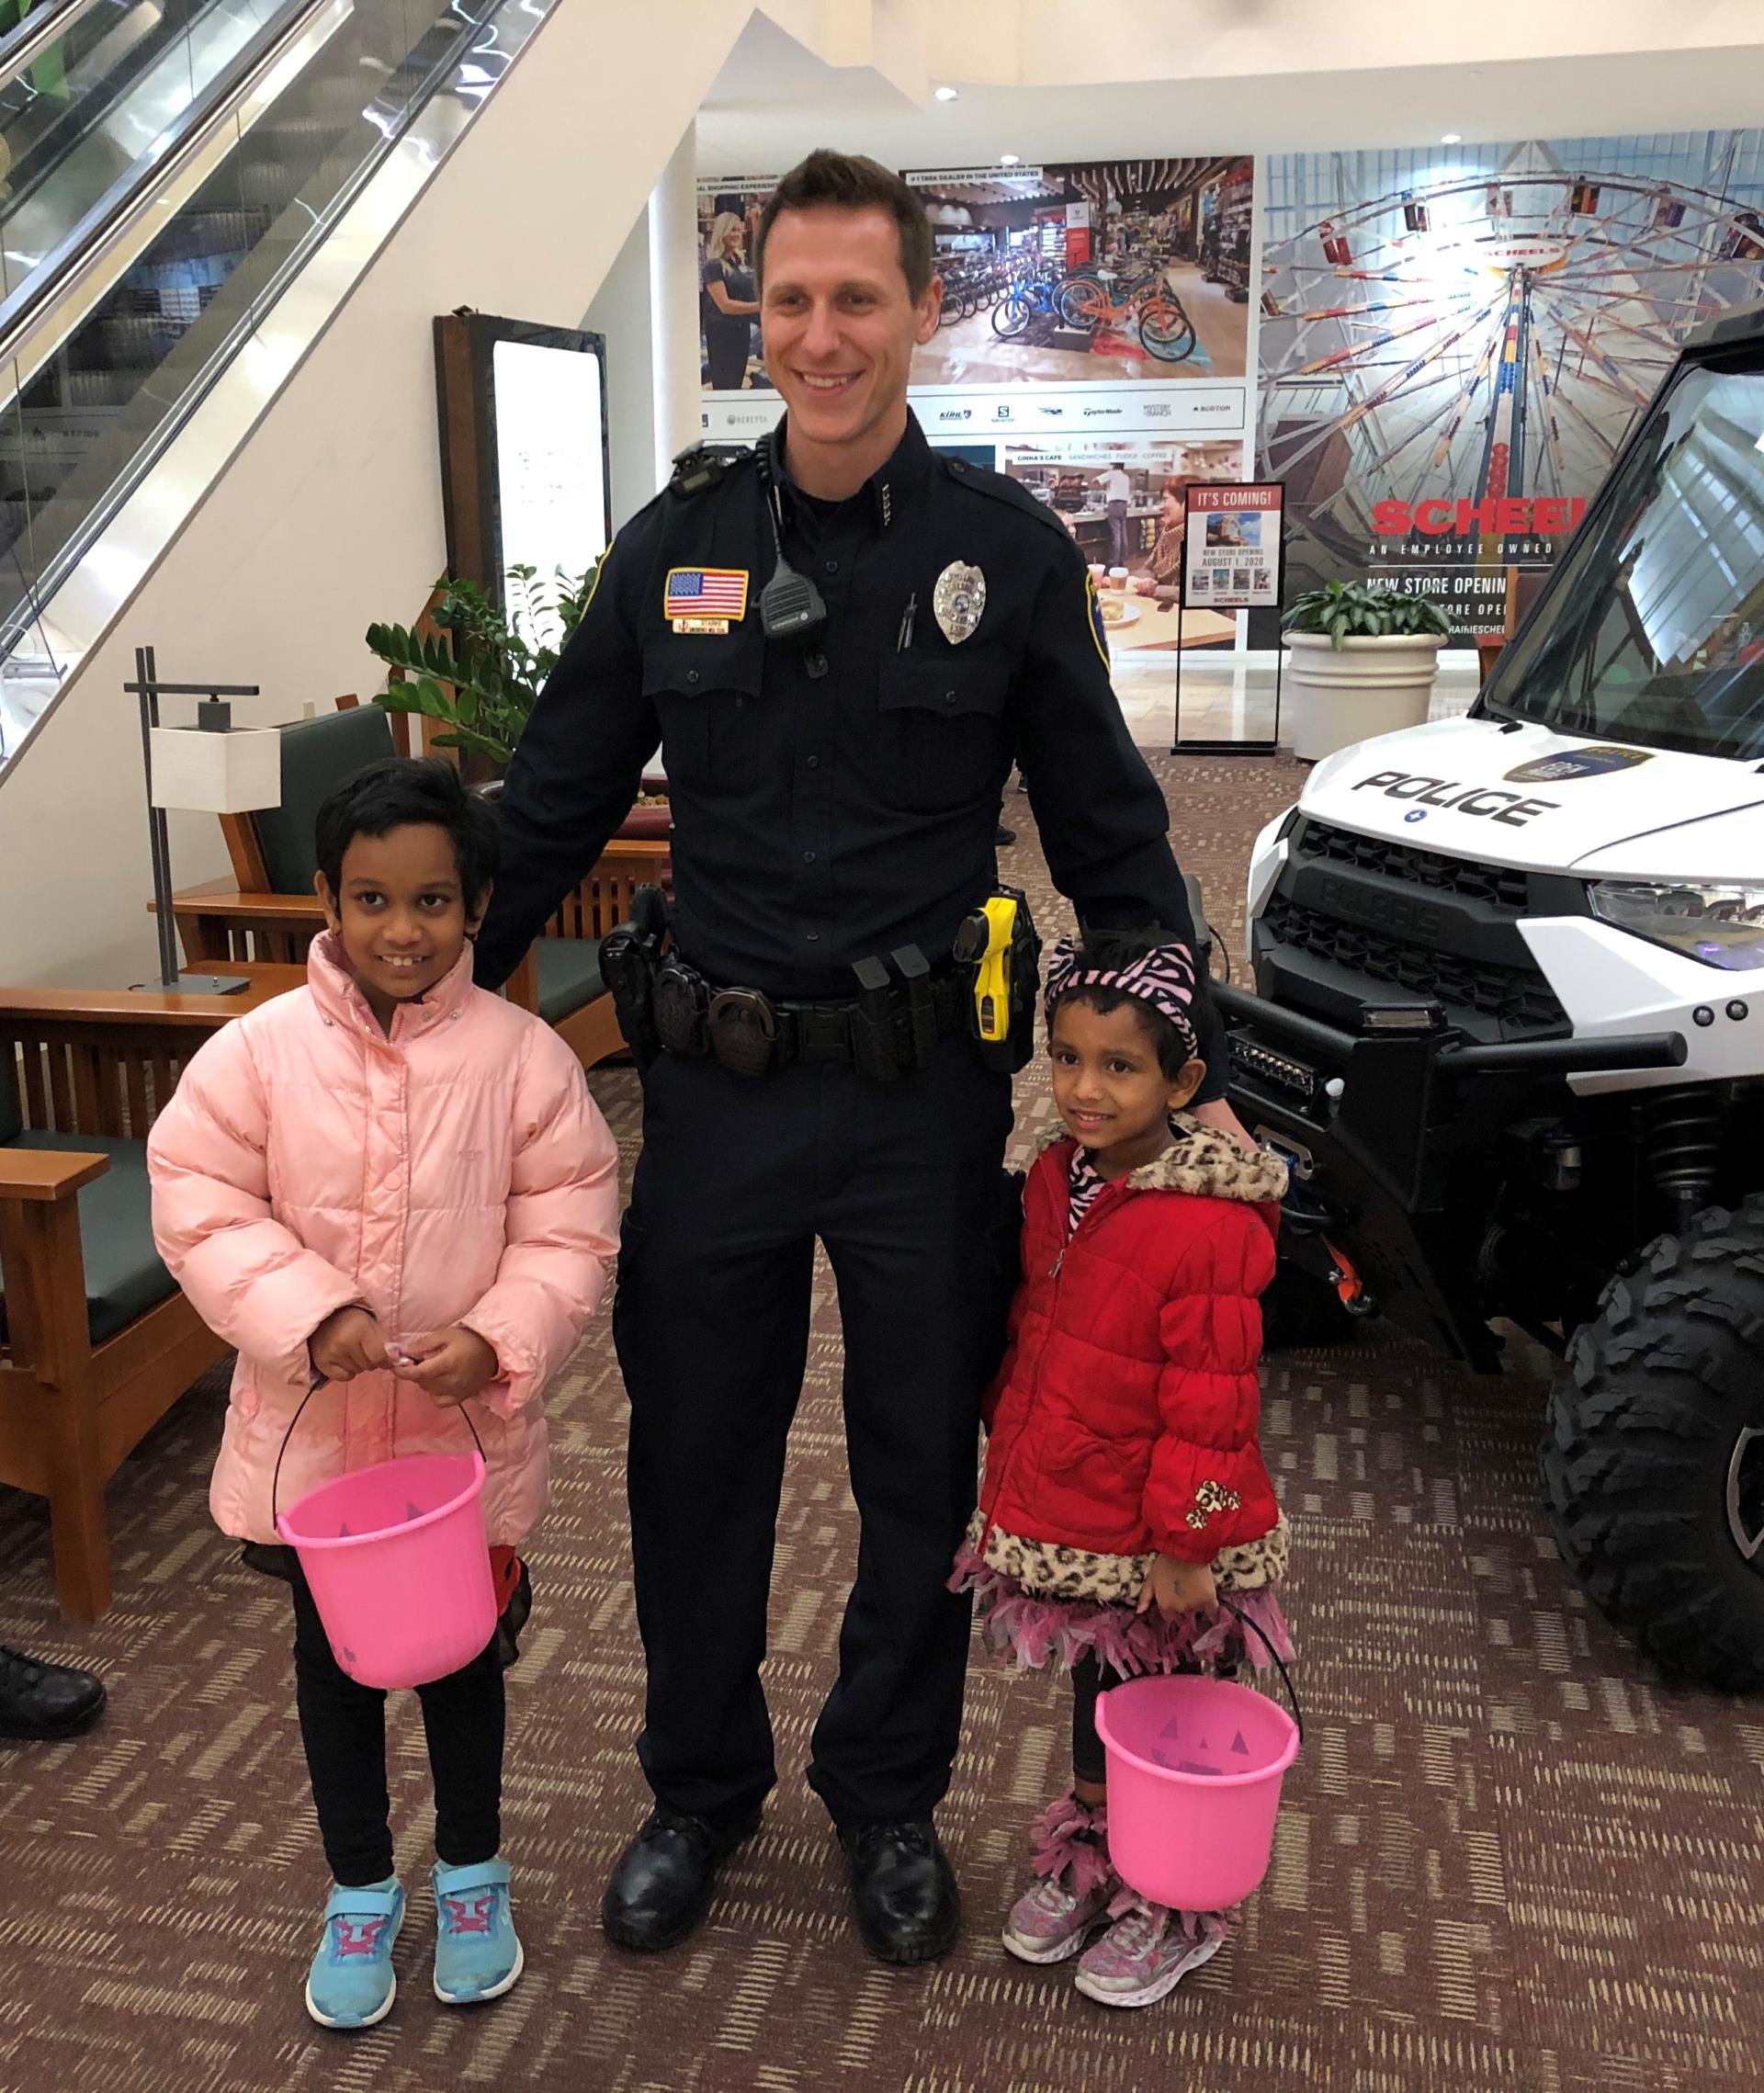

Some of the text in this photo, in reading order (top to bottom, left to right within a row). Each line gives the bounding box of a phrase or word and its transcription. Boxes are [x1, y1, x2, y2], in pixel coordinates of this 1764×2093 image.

[1484, 248, 1560, 256] SCHEELS
[1083, 408, 1123, 416] TaylorMade
[1197, 491, 1272, 506] IT'S COMING!
[1369, 543, 1553, 556] AN EMPLOYEE OWNED
[1202, 558, 1232, 567] AUGUST
[1245, 557, 1264, 566] 2020
[1404, 576, 1449, 594] STORE
[1440, 604, 1470, 616] ORE
[1351, 771, 1563, 828] POLICE
